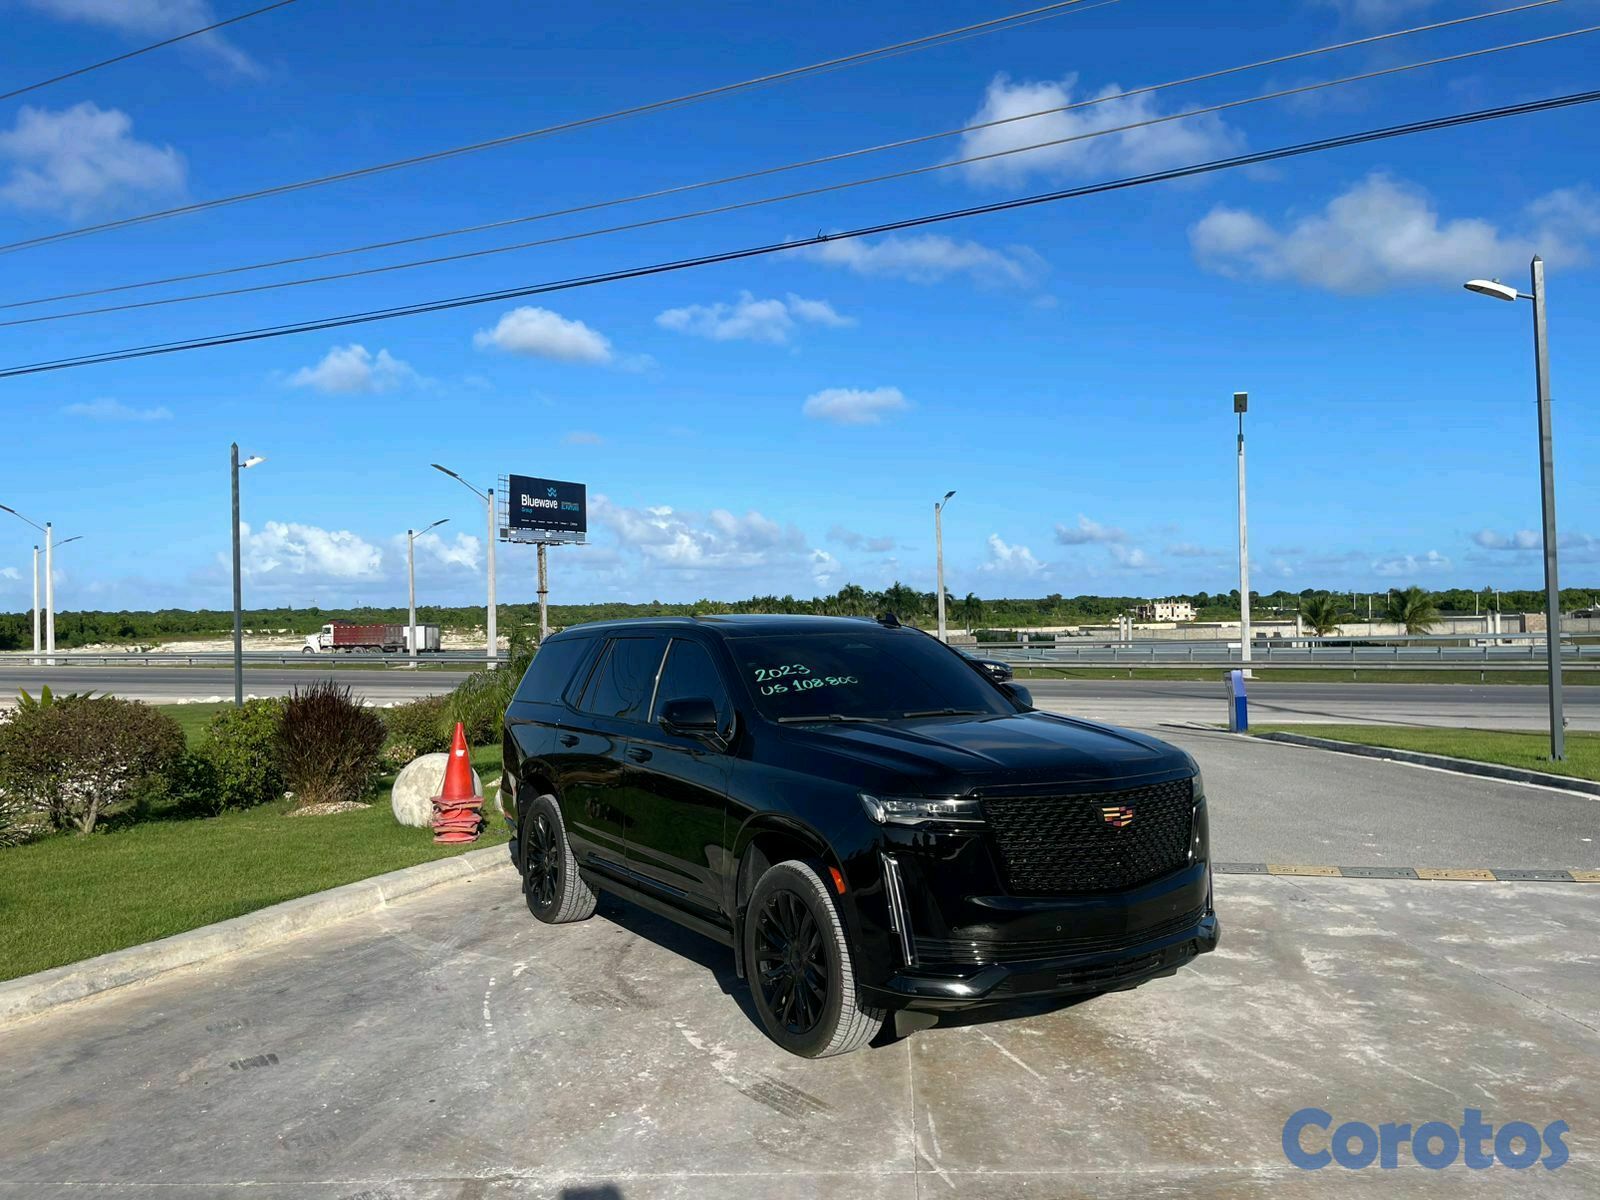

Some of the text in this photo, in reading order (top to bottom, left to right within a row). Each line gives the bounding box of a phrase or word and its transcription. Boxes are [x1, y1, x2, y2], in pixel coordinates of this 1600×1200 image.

[521, 494, 558, 509] Bluewave
[755, 664, 811, 682] 2023
[760, 684, 788, 696] US
